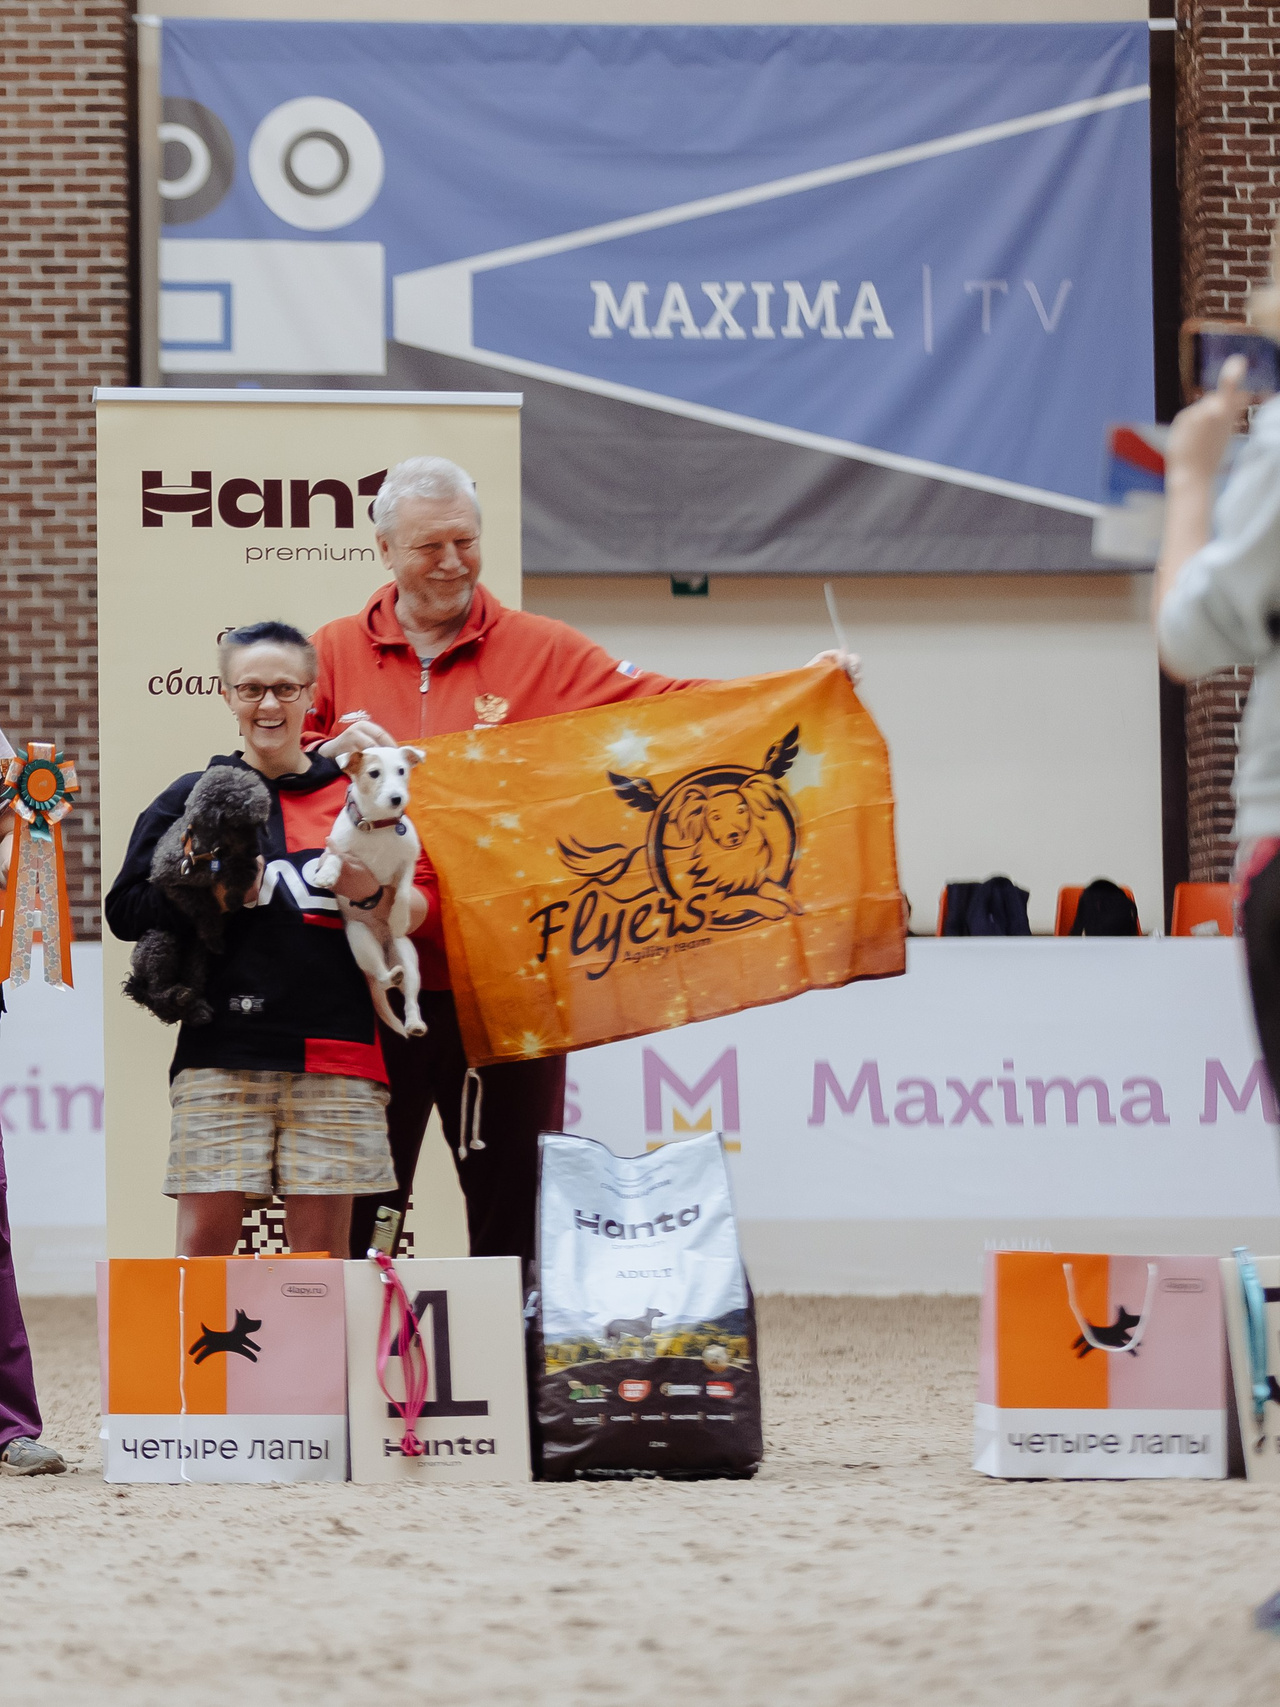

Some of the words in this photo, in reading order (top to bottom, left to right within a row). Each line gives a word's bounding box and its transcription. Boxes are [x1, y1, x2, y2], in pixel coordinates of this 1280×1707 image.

[589, 280, 894, 340] MAXIMA
[963, 279, 1074, 334] TV
[142, 469, 388, 528] Han
[246, 544, 375, 563] premium
[529, 890, 709, 980] Flyers
[807, 1058, 1171, 1127] Maxima
[574, 1204, 700, 1240] Hanta
[616, 1267, 673, 1279] ADULT
[387, 1290, 489, 1418] 1
[121, 1438, 238, 1460] четыре
[247, 1438, 330, 1460] лапы
[1007, 1433, 1120, 1455] четыре
[1127, 1433, 1210, 1455] лапы
